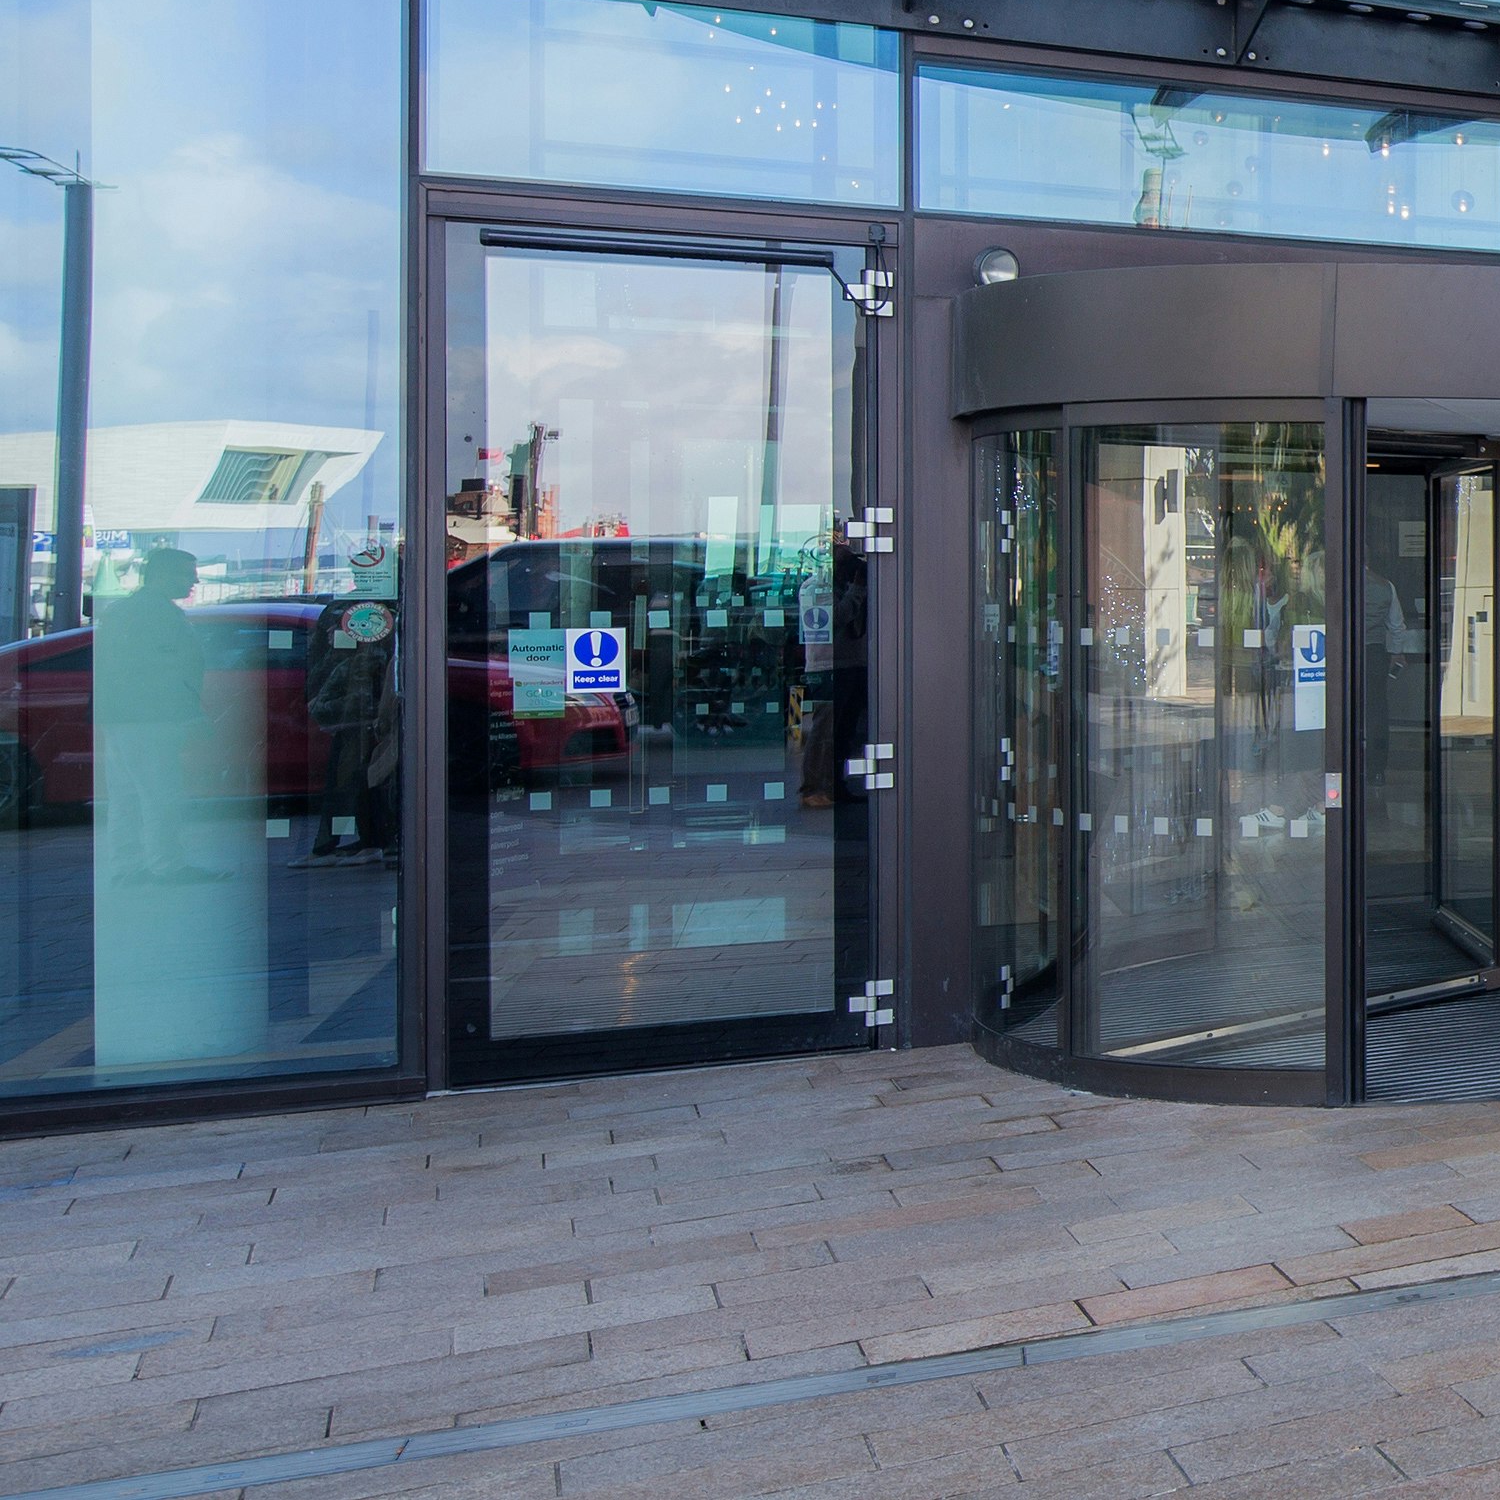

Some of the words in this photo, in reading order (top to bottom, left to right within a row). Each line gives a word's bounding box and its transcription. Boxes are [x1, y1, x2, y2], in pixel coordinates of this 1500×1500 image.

[511, 644, 565, 653] Automatic
[526, 654, 551, 662] door
[574, 675, 596, 684] Keep
[598, 674, 619, 683] clear
[525, 689, 553, 699] GOLD
